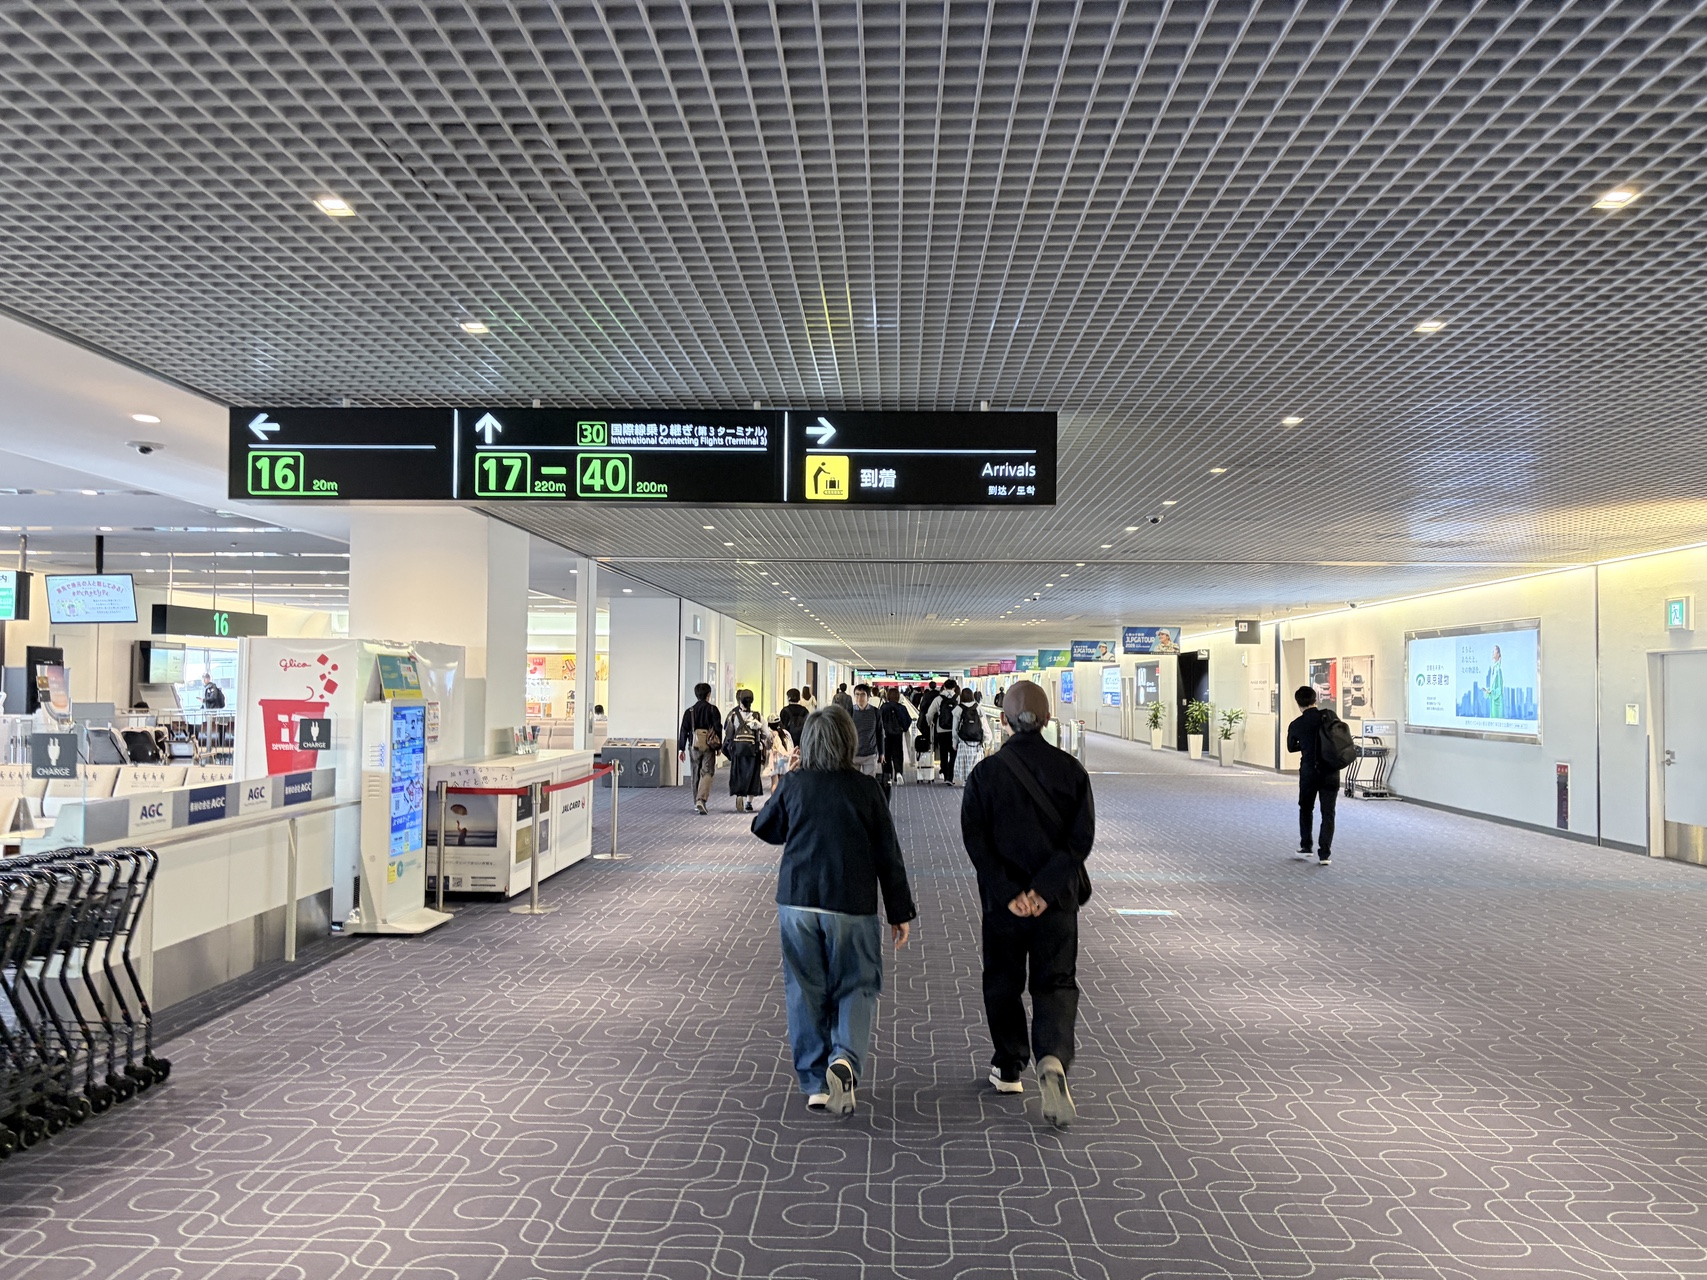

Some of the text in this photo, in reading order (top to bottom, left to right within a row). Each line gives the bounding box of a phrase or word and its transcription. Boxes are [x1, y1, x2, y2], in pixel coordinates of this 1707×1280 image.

[580, 424, 605, 443] 30
[610, 435, 768, 447] International Connecting Flights (Terminal 3)
[254, 457, 339, 491] 16 20m
[481, 457, 668, 493] 17 220m 40 200m
[981, 462, 1037, 477] Arrivals
[860, 468, 897, 488] 到着
[213, 612, 229, 636] 16
[279, 658, 312, 672] Glico
[1426, 674, 1449, 686] 東京建物
[302, 741, 327, 749] CHARGE
[36, 766, 71, 777] CHARGE
[247, 785, 266, 800] AGC
[139, 802, 163, 820] AGC
